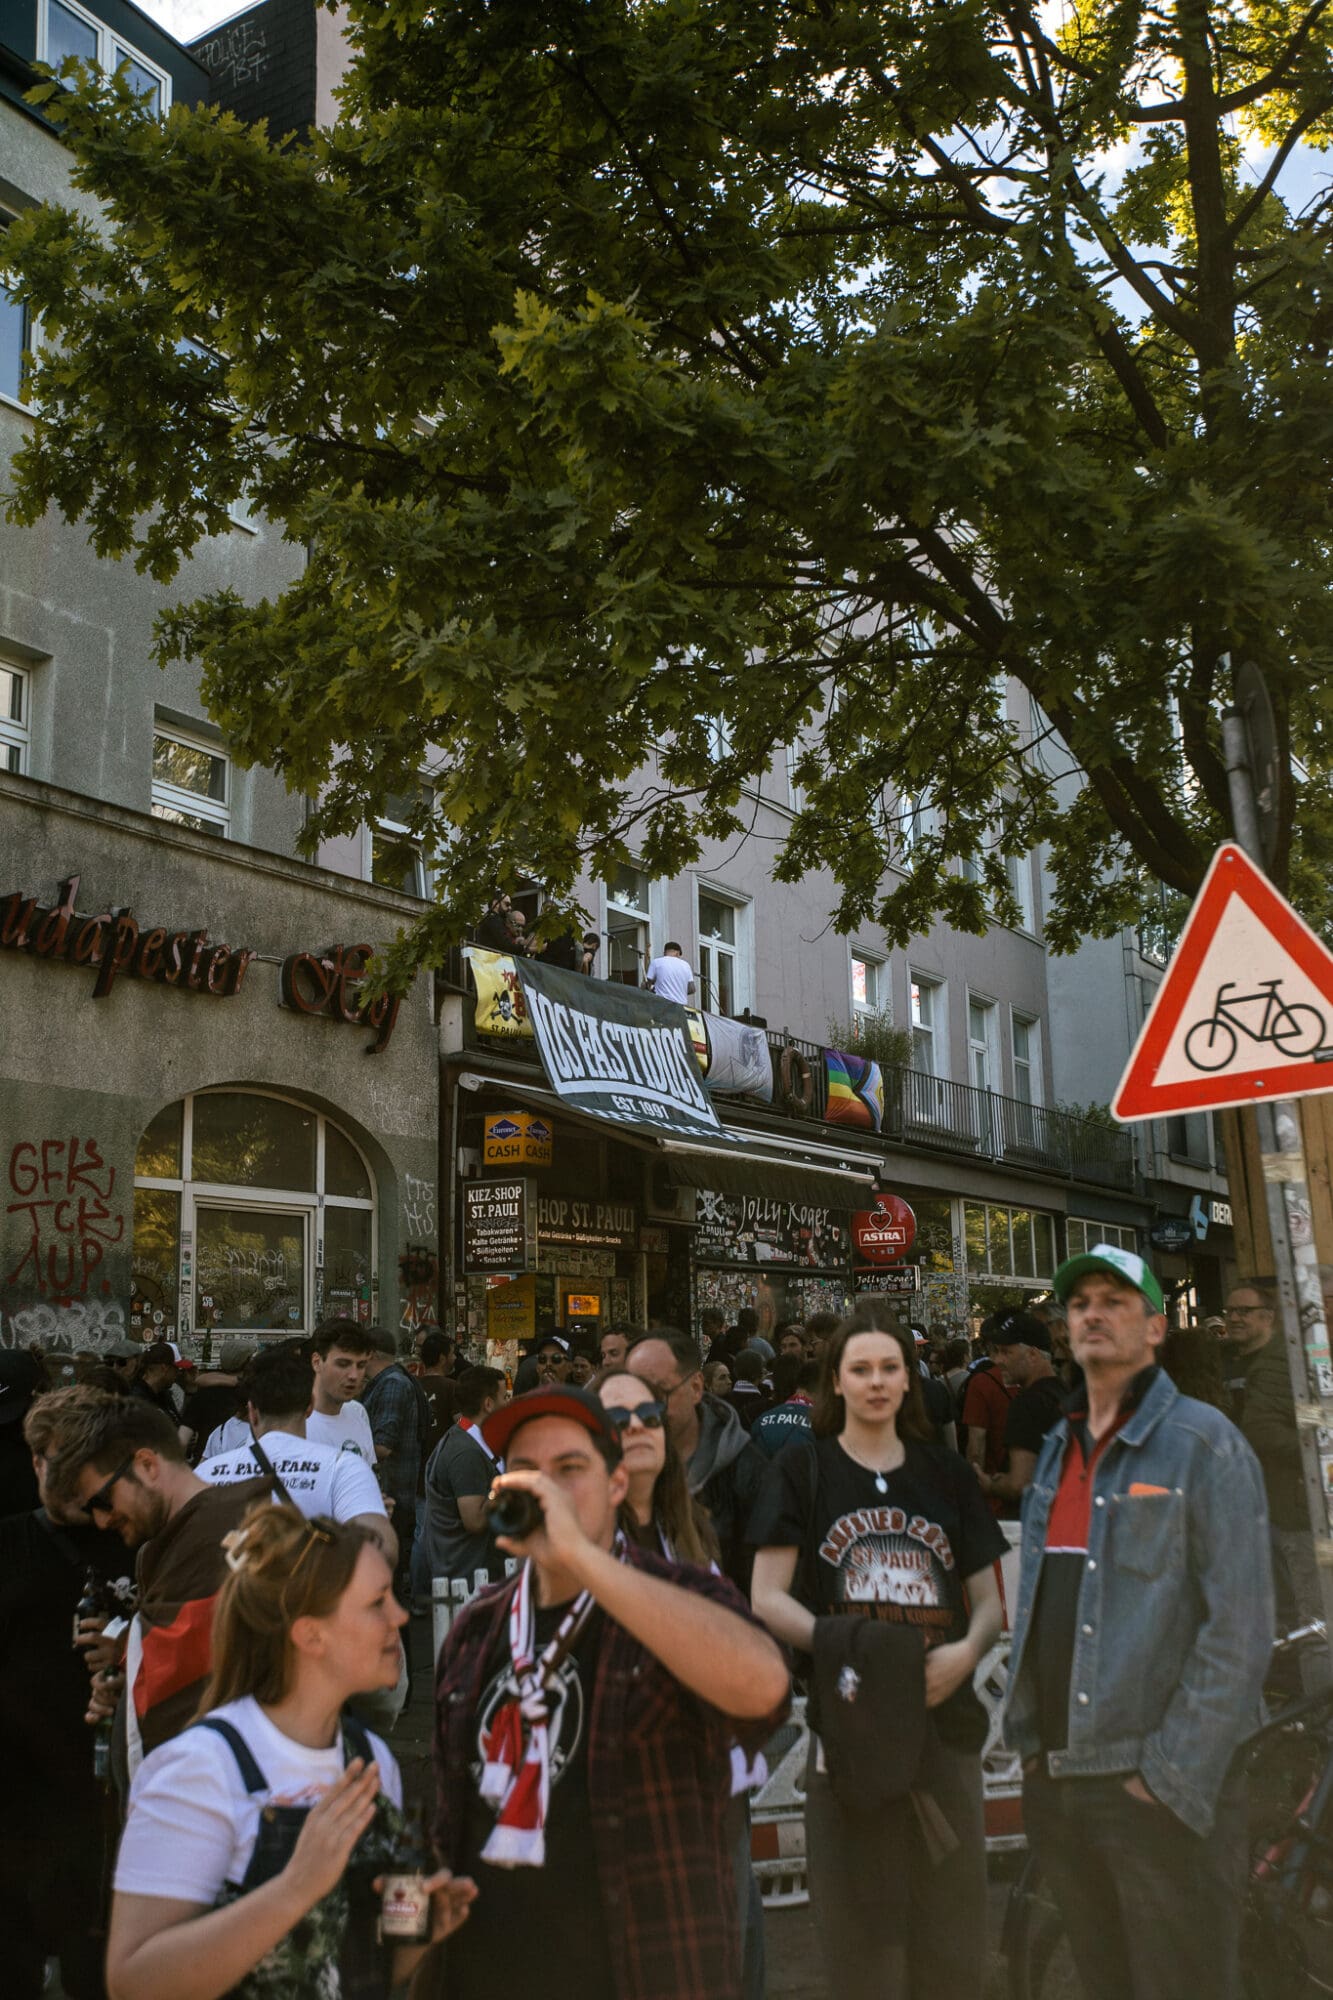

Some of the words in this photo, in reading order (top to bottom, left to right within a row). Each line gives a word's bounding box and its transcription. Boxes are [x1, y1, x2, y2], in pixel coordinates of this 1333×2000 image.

[611, 1094, 641, 1114] EST.
[638, 1100, 670, 1120] 1991
[487, 1144, 520, 1158] CASH
[525, 1144, 551, 1160] CASH
[467, 1186, 522, 1203] KIEZ-SHOP
[471, 1205, 486, 1219] ST.
[488, 1202, 519, 1218] PAULI
[538, 1199, 568, 1226] HOP
[571, 1203, 593, 1229] ST.
[596, 1206, 635, 1233] PAULI
[737, 1195, 781, 1243] Jolly
[476, 1228, 514, 1237] Tabakwaren
[863, 1231, 901, 1242] ASTRA
[471, 1238, 488, 1246] Kalte
[489, 1235, 518, 1245] Getränke
[476, 1246, 514, 1256] Süßigkeiten
[483, 1256, 507, 1264] Snacks
[761, 1414, 775, 1427] ST.
[211, 1464, 230, 1476] ST.
[851, 1545, 873, 1566] ST
[880, 1550, 931, 1571] PAULI
